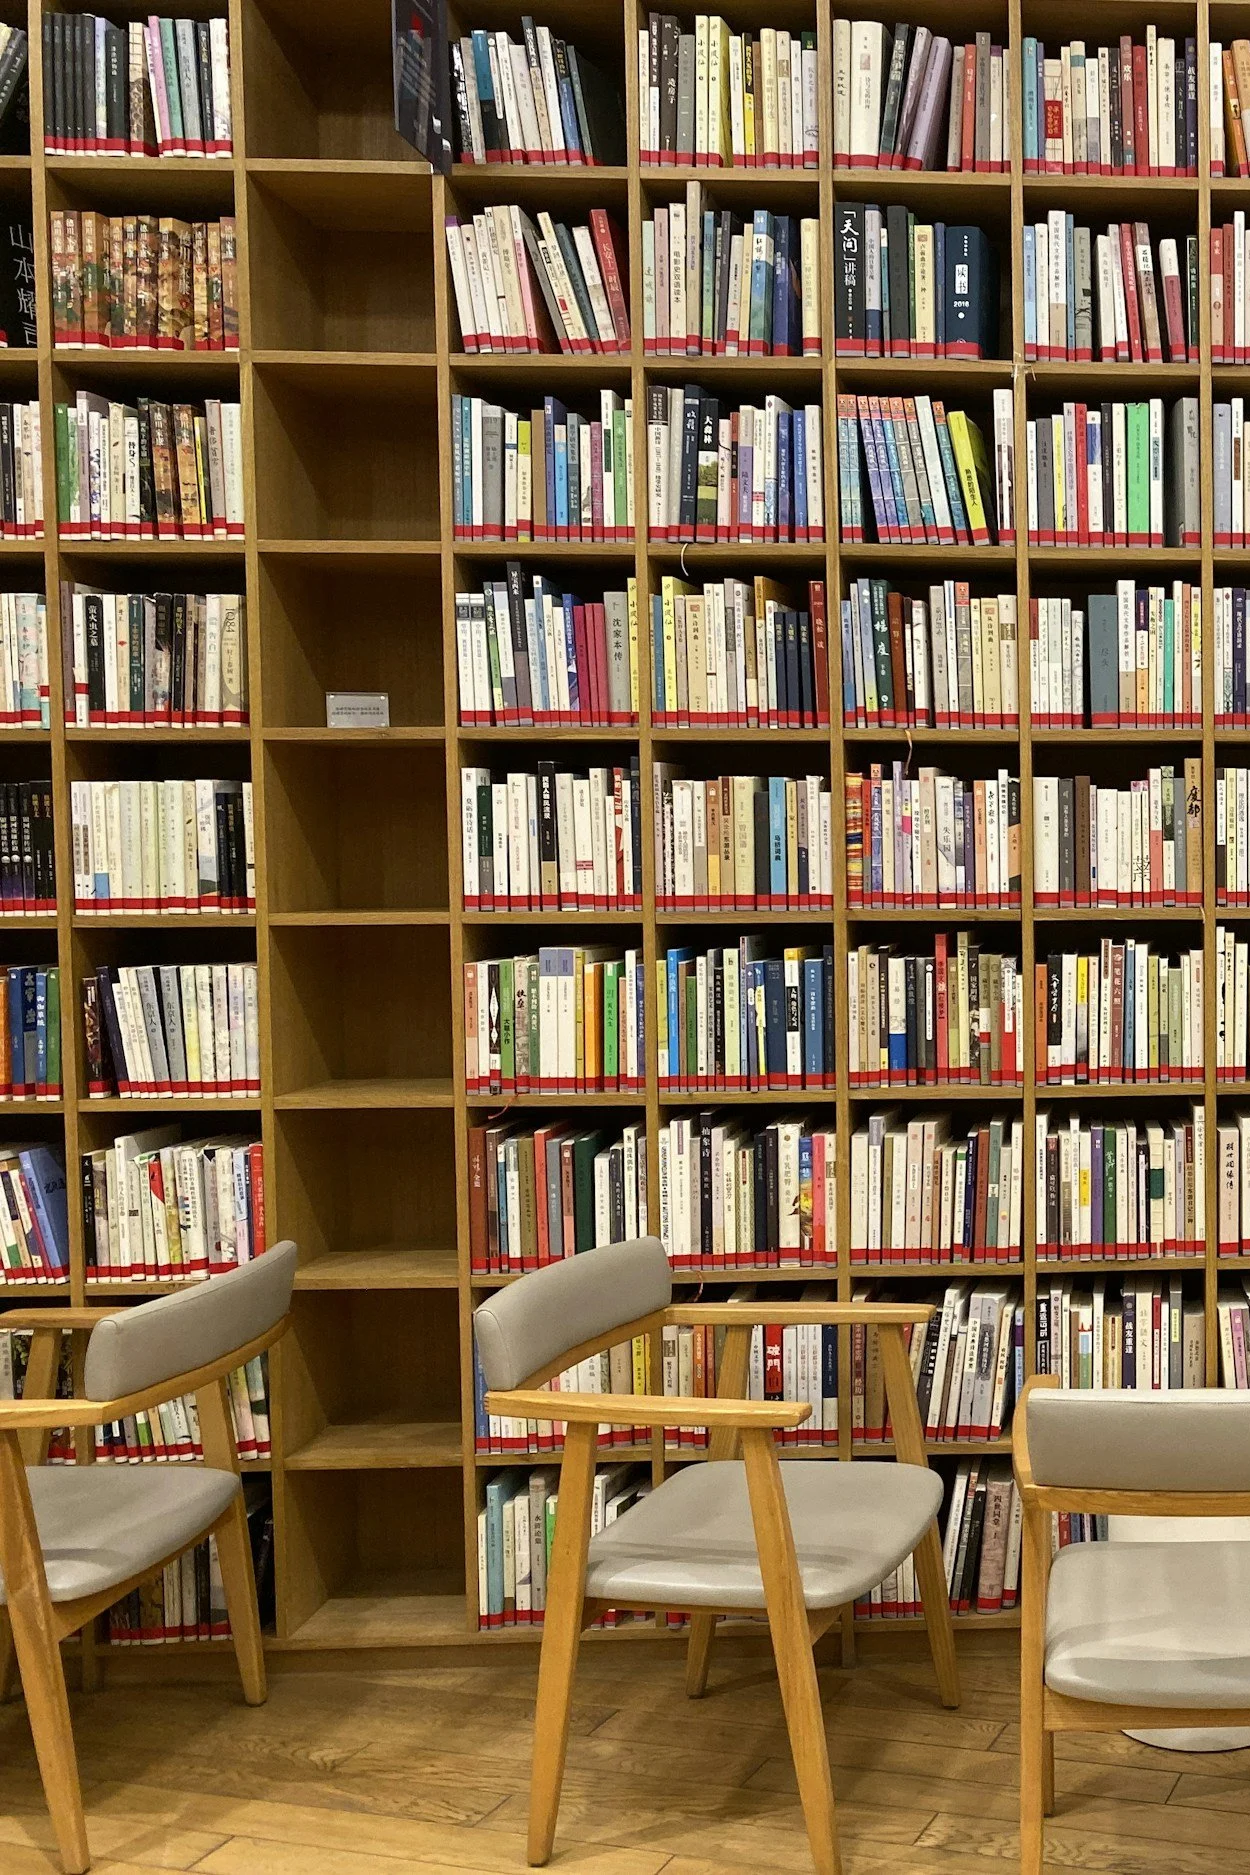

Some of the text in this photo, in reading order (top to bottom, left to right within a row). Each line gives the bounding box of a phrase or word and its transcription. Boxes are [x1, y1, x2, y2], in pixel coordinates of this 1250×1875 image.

[1123, 64, 1132, 82] 欢乐
[1187, 66, 1197, 101] 战友重逢
[667, 77, 677, 105] 造房子
[840, 209, 860, 287] 「天问」讲稿
[602, 243, 622, 292] 长安十二时辰
[673, 250, 681, 304] 电影史双语读本
[957, 266, 968, 292] 读书
[703, 416, 713, 445] 大森林
[965, 468, 978, 507] 熟悉的陌生人
[225, 608, 235, 634] 1Q84
[774, 834, 782, 862] 马桥词典
[943, 826, 951, 852] 失乐园
[25, 972, 36, 1024] 太宰治
[166, 1001, 176, 1027] 东京人
[516, 989, 527, 1009] 扶桑
[146, 1002, 157, 1027] 东京人
[702, 1126, 710, 1158] 抽象诗
[784, 1154, 792, 1187] 丰乳肥臀
[1125, 1321, 1134, 1354] 战友重逢
[993, 1494, 1002, 1526] 四世同堂
[534, 1513, 542, 1546] 水浒论集
